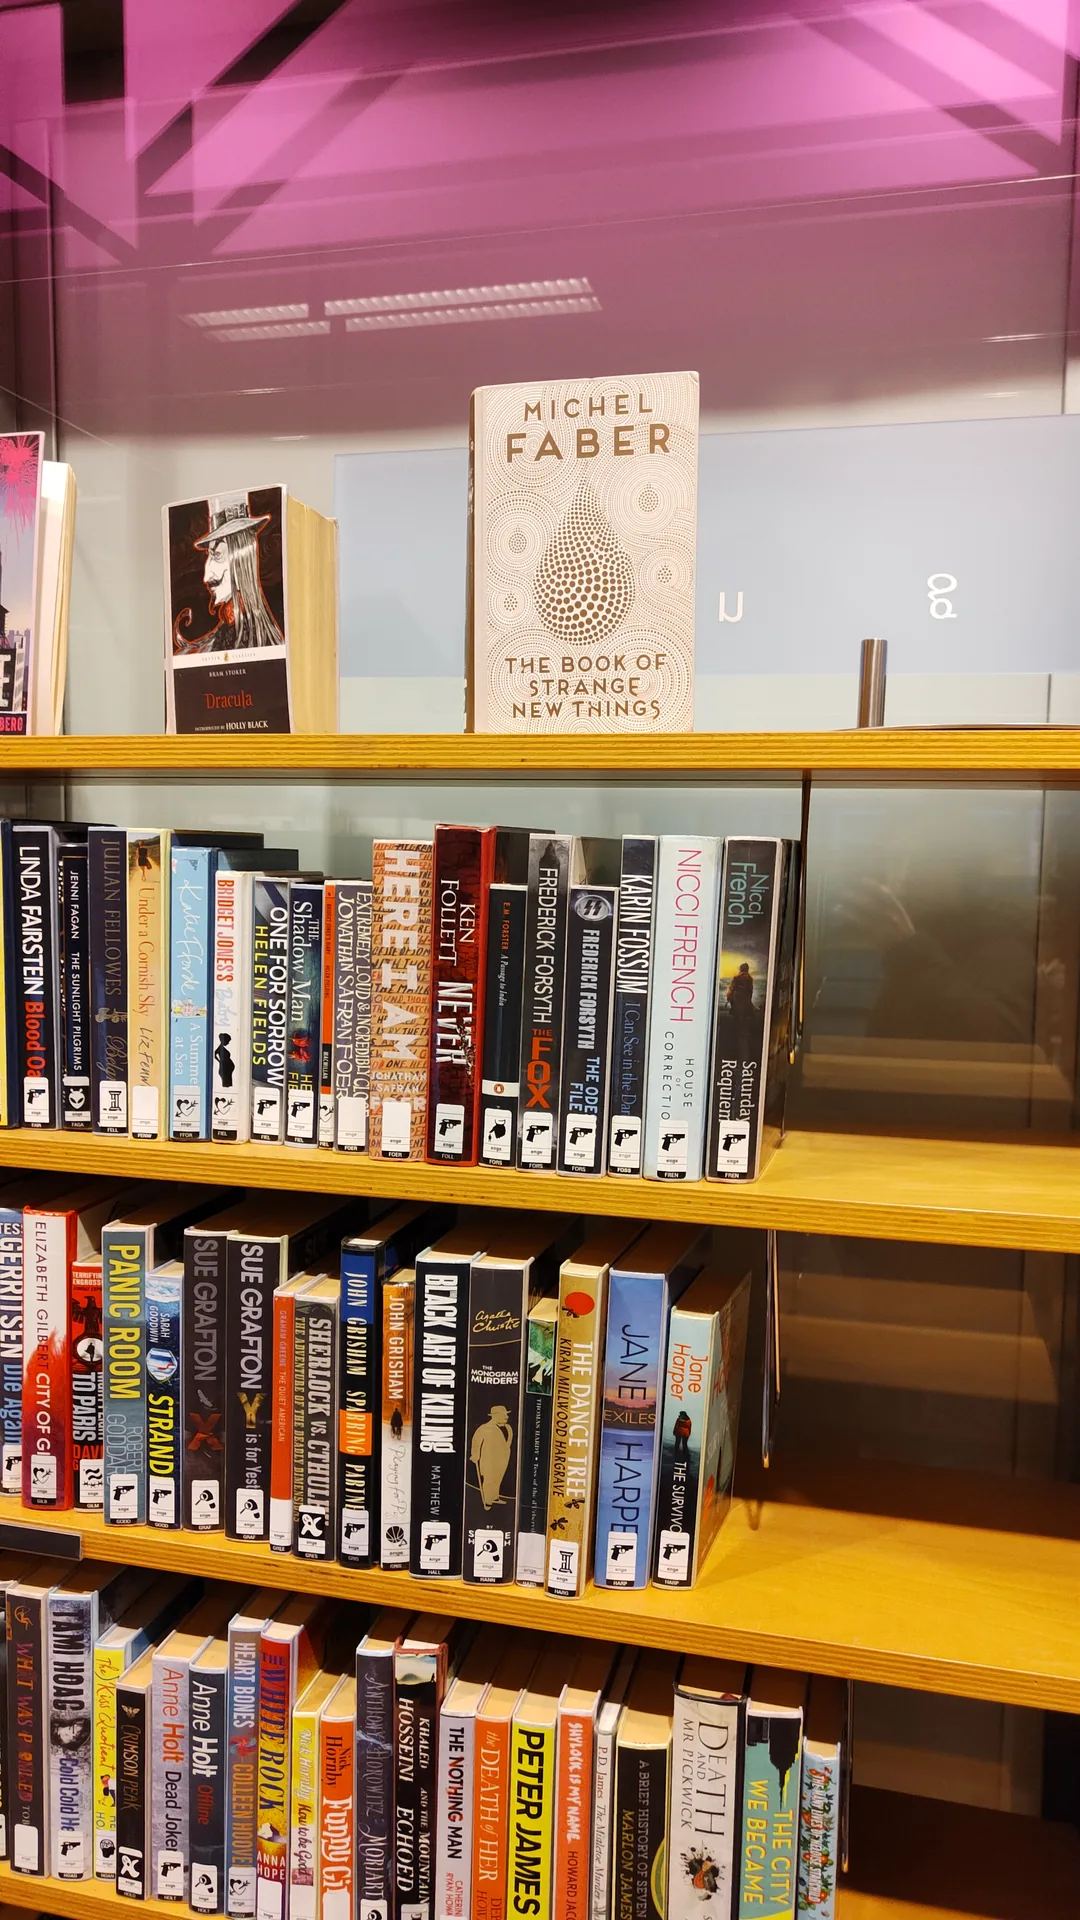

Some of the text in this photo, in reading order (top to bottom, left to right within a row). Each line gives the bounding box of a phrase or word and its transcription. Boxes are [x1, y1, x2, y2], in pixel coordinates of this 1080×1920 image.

[524, 393, 653, 422] MICHEL
[506, 423, 671, 463] FABER
[225, 669, 247, 677] STOKER
[504, 653, 667, 674] THE BOOK OF
[529, 677, 641, 697] STRANGE
[204, 689, 254, 710] Dracula
[512, 700, 661, 720] NEW THINGS
[226, 721, 247, 731] HOLLY
[248, 720, 269, 729] BLACK
[70, 870, 80, 939] JENNI FAGAN
[101, 838, 122, 996] JULIAN FELLOWES
[138, 887, 155, 930] Under
[727, 861, 757, 926] French
[747, 874, 770, 915] Nicci
[19, 846, 44, 995] LINDA FAIRSTEIN
[309, 918, 320, 941] THE
[438, 879, 460, 966] FOLLETT
[459, 903, 476, 943] KEN
[501, 920, 510, 950] FORSTER
[532, 867, 558, 1024] FREDERICK FORSYTH
[670, 848, 703, 1024] NICCI FRENCH
[138, 939, 156, 995] Cornish
[355, 891, 373, 1077] EXTREMELY LOUD & INCREDIBLY
[70, 951, 83, 1071] THE SUNLIGHT PILGRIMS
[131, 996, 156, 1018] Sky
[252, 925, 268, 1065] HELEN FIELDS
[624, 1009, 640, 1031] Can
[25, 1001, 46, 1051] Blood
[532, 1028, 553, 1037] THE
[623, 1032, 640, 1056] See
[370, 1072, 427, 1082] JONATHAN
[376, 1084, 420, 1093] SAFRAN
[621, 1073, 638, 1091] the
[622, 1058, 638, 1070] in
[675, 1077, 681, 1087] OF
[683, 1058, 695, 1108] HOUSE
[35, 1221, 49, 1370] ELIZABETH GILBERT
[108, 1243, 142, 1399] PANIC ROOM
[192, 1238, 219, 1382] SUE GRAFTON
[240, 1243, 264, 1390] SUE GRAFTON
[150, 1305, 159, 1343] GOODWIN
[159, 1313, 171, 1338] SARAH
[344, 1271, 368, 1376] JOHN GRISHAM
[278, 1310, 287, 1442] GRAHAM GREENE THE QUIET AMERICAN
[307, 1317, 332, 1417] SHERLOCK
[470, 1368, 519, 1378] MONOGRAM
[471, 1375, 519, 1386] MURDERS
[617, 1324, 650, 1400] JANE
[666, 1342, 692, 1402] Harper
[687, 1355, 709, 1394] Jane
[36, 1372, 51, 1434] CITY OF
[293, 1316, 306, 1465] THE ADVENTURE OF THE DEADLY
[552, 1337, 572, 1498] KIRAN MILLWOOD HARGRAVE
[430, 1465, 441, 1516] MATTHEW
[52, 1609, 85, 1711] TAMI HOAG
[232, 1642, 256, 1729] HEART BONES
[162, 1667, 185, 1763] Anne Holt
[192, 1680, 218, 1778] Anne Holt
[120, 1724, 142, 1811] CRIMSON PEAK
[297, 1729, 315, 1803] Nick Hornby
[419, 1717, 430, 1769] KHALED
[696, 1751, 706, 1780] AND
[420, 1787, 428, 1808] AND
[596, 1771, 607, 1799] James
[680, 1718, 694, 1829] MR PICKWICK
[694, 1721, 729, 1836] DEATH
[297, 1803, 312, 1827] How
[297, 1827, 310, 1836] to
[420, 1809, 428, 1828] THE
[478, 1730, 501, 1882] the DEATH of HER
[513, 1728, 545, 1916] PETER JAMES
[596, 1804, 607, 1821] The
[636, 1760, 650, 1918] A BRIEF HISTORY OF SEVEN
[743, 1779, 769, 1905] WE BECAME
[769, 1810, 795, 1905] THE CITY
[593, 1866, 604, 1900] Murder
